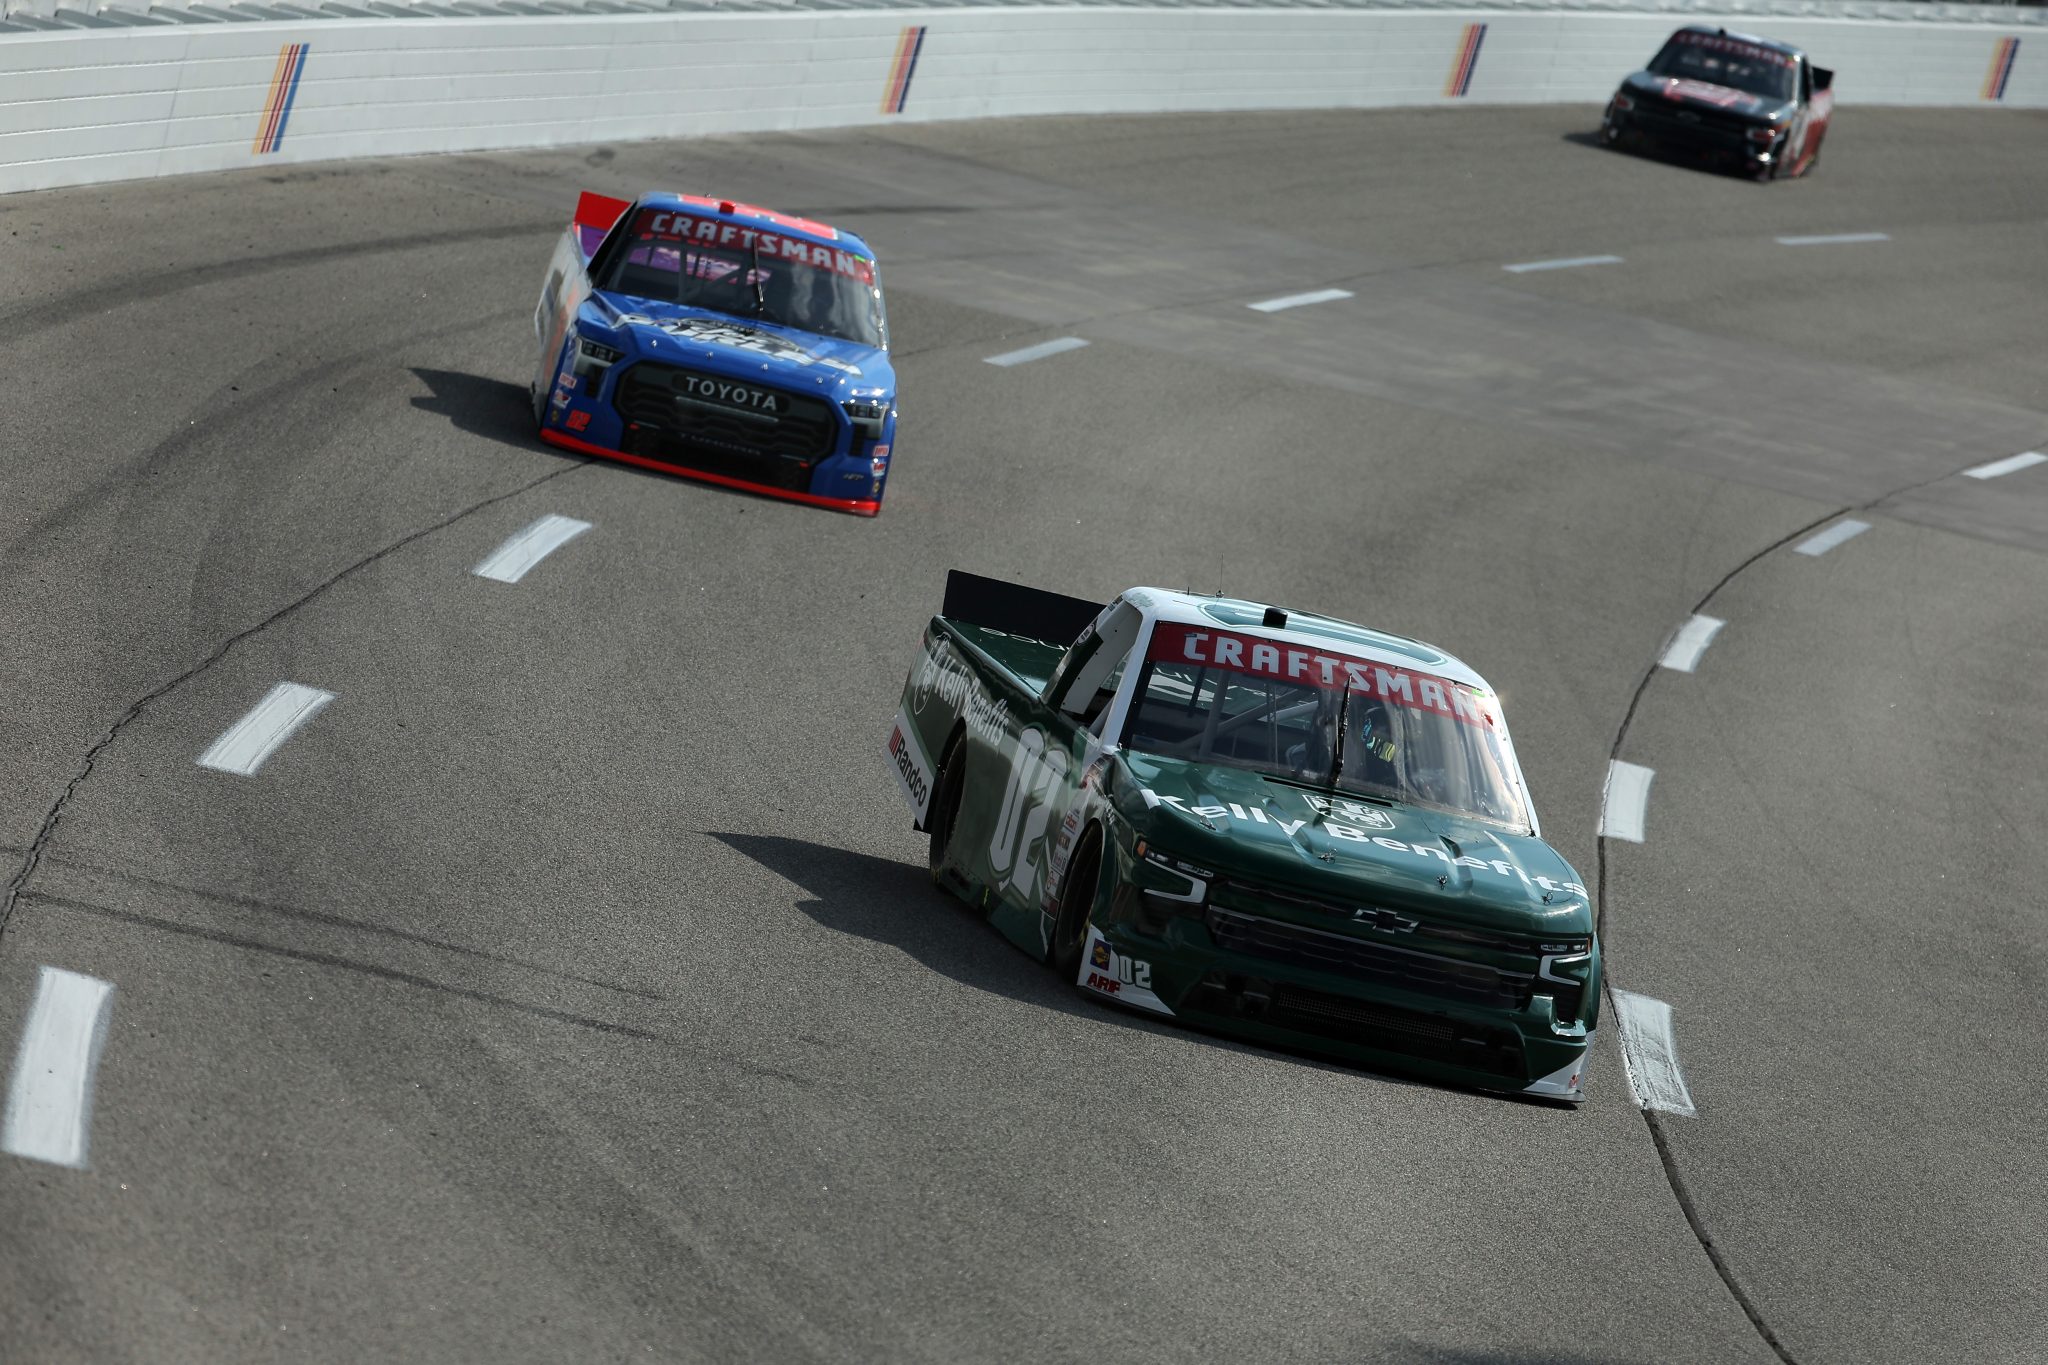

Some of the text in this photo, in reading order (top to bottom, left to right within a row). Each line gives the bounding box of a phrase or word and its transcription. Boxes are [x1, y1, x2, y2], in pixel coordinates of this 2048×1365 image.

[651, 213, 855, 275] CRAFTSMAN
[686, 376, 777, 411] TOYOTA
[1183, 632, 1479, 722] CRAFTSMAN
[893, 735, 928, 807] Randco
[989, 728, 1067, 899] 02
[1140, 788, 1306, 836] Kelly
[1327, 822, 1589, 900] Benefits
[1119, 955, 1152, 989] 02
